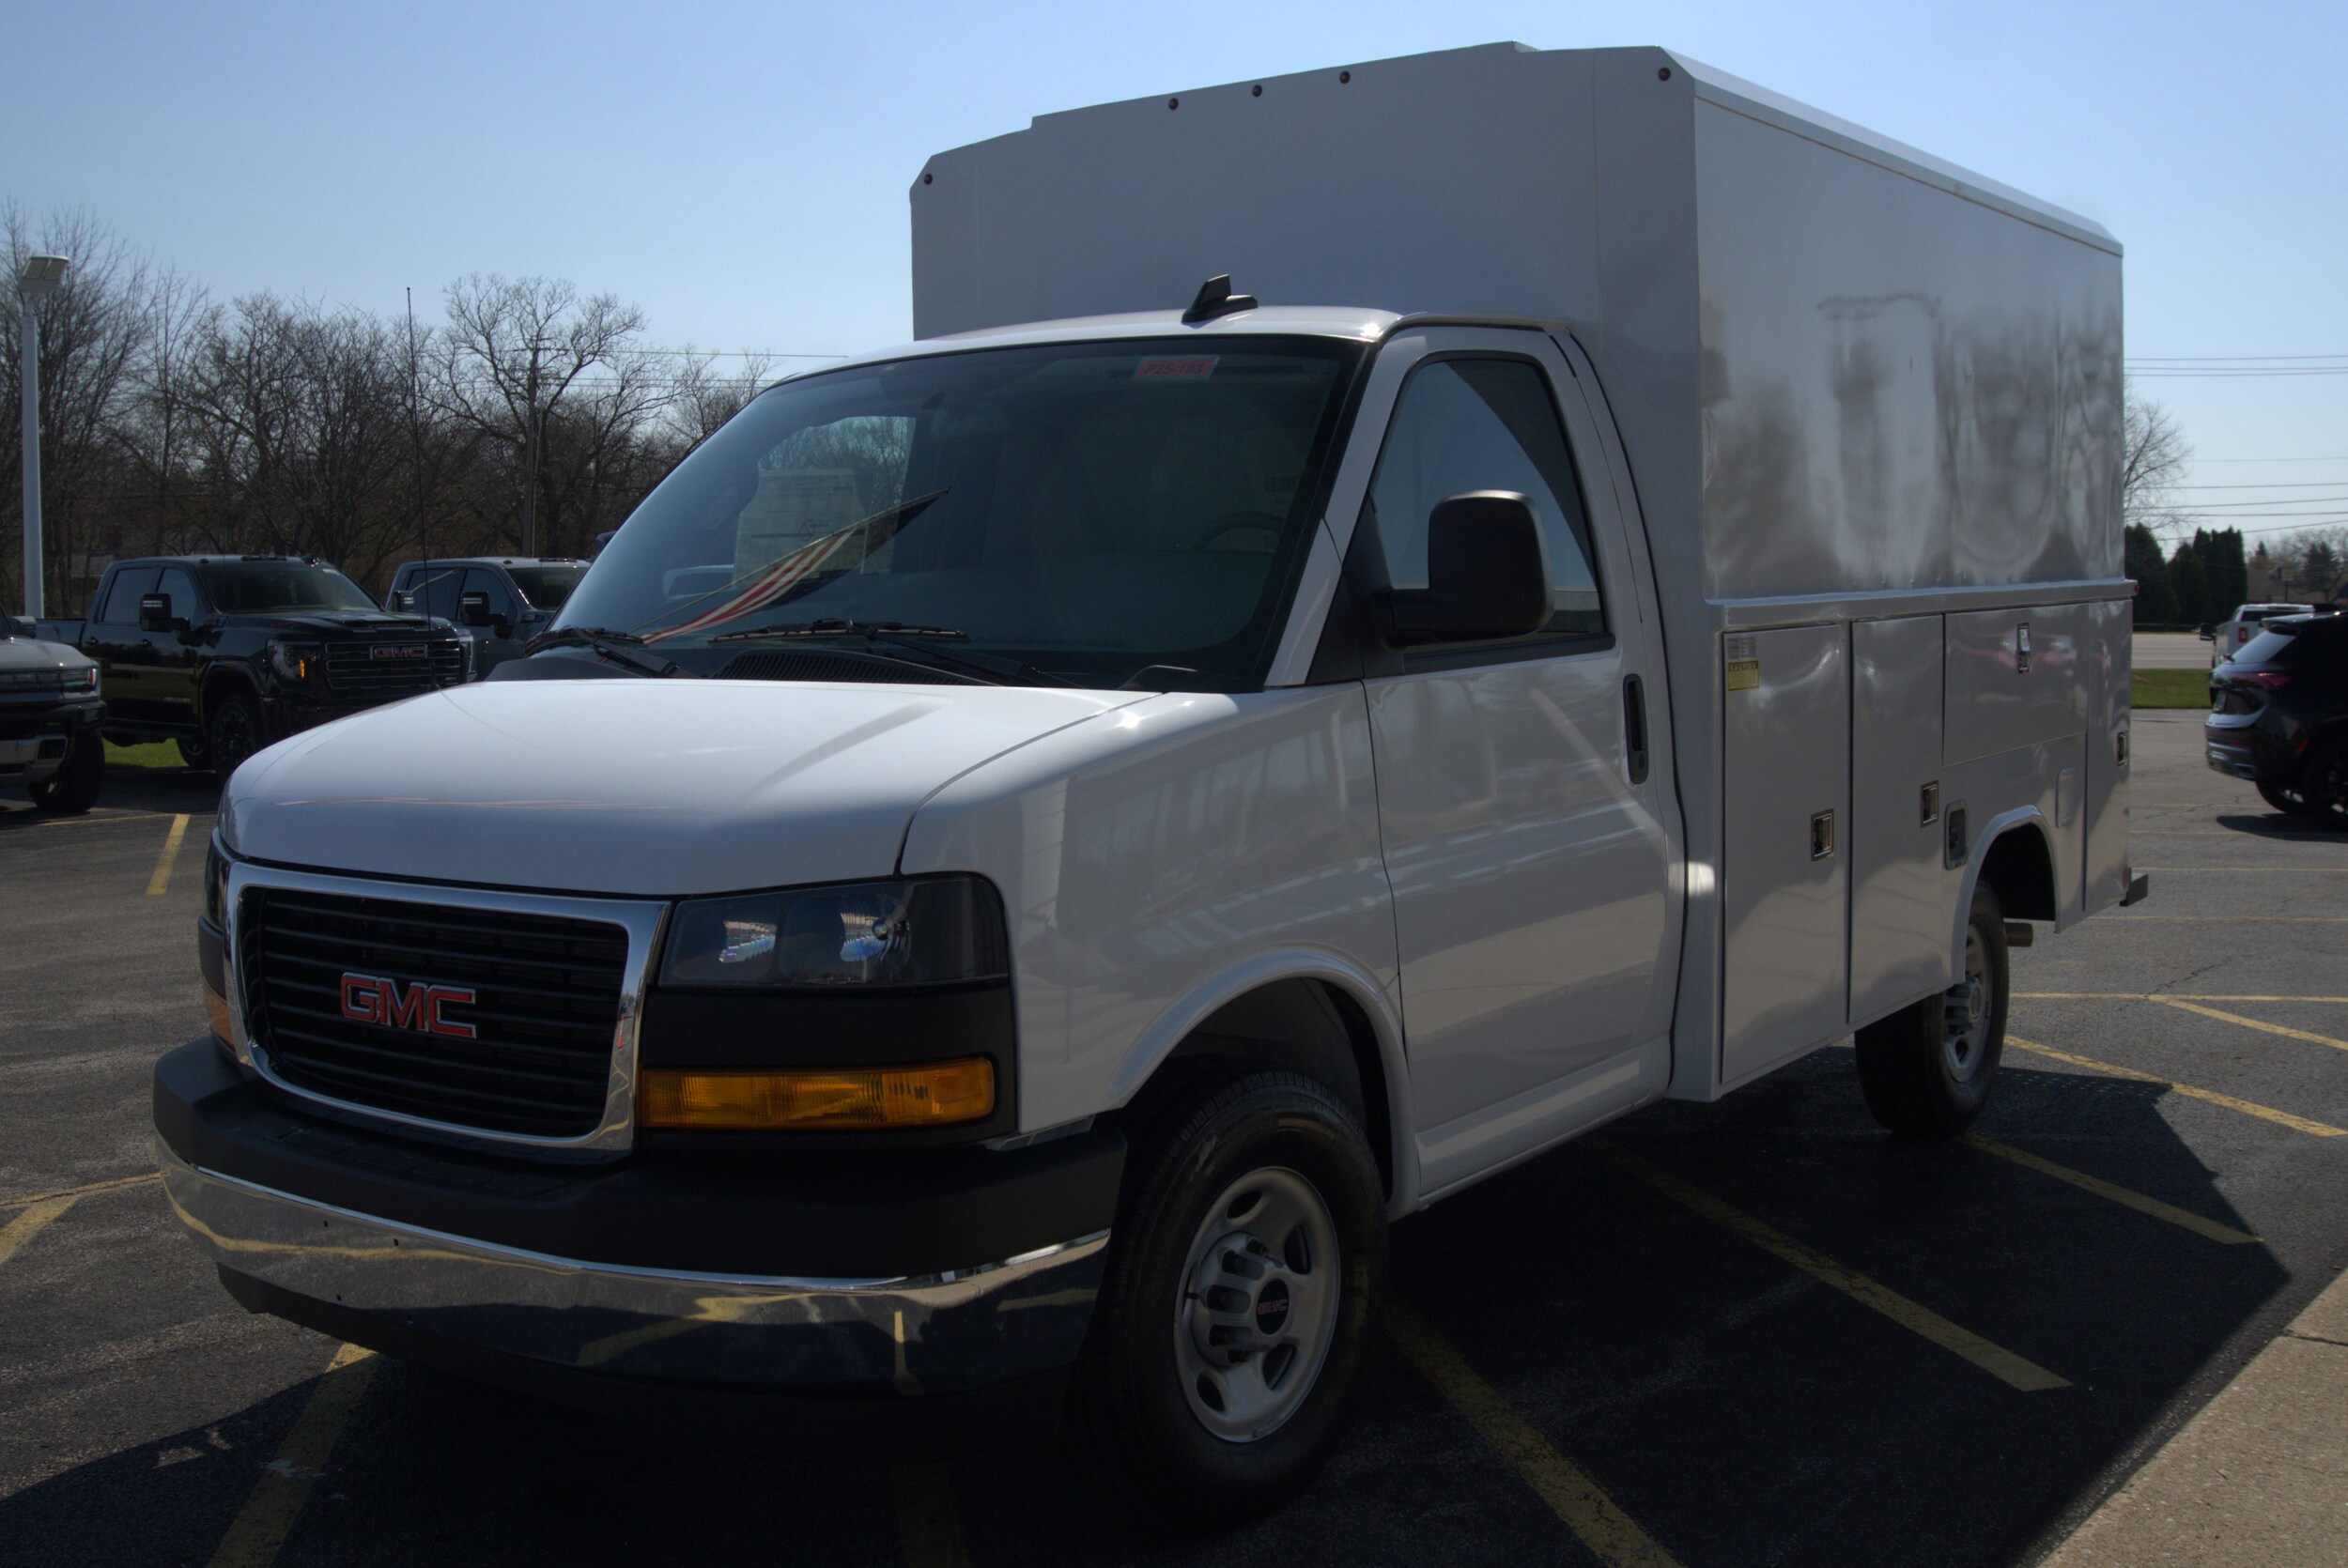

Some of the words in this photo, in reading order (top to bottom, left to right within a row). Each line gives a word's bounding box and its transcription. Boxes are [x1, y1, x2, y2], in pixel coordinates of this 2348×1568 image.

[375, 646, 425, 659] GMC
[340, 971, 477, 1039] GMC
[1257, 1299, 1288, 1314] GMC
